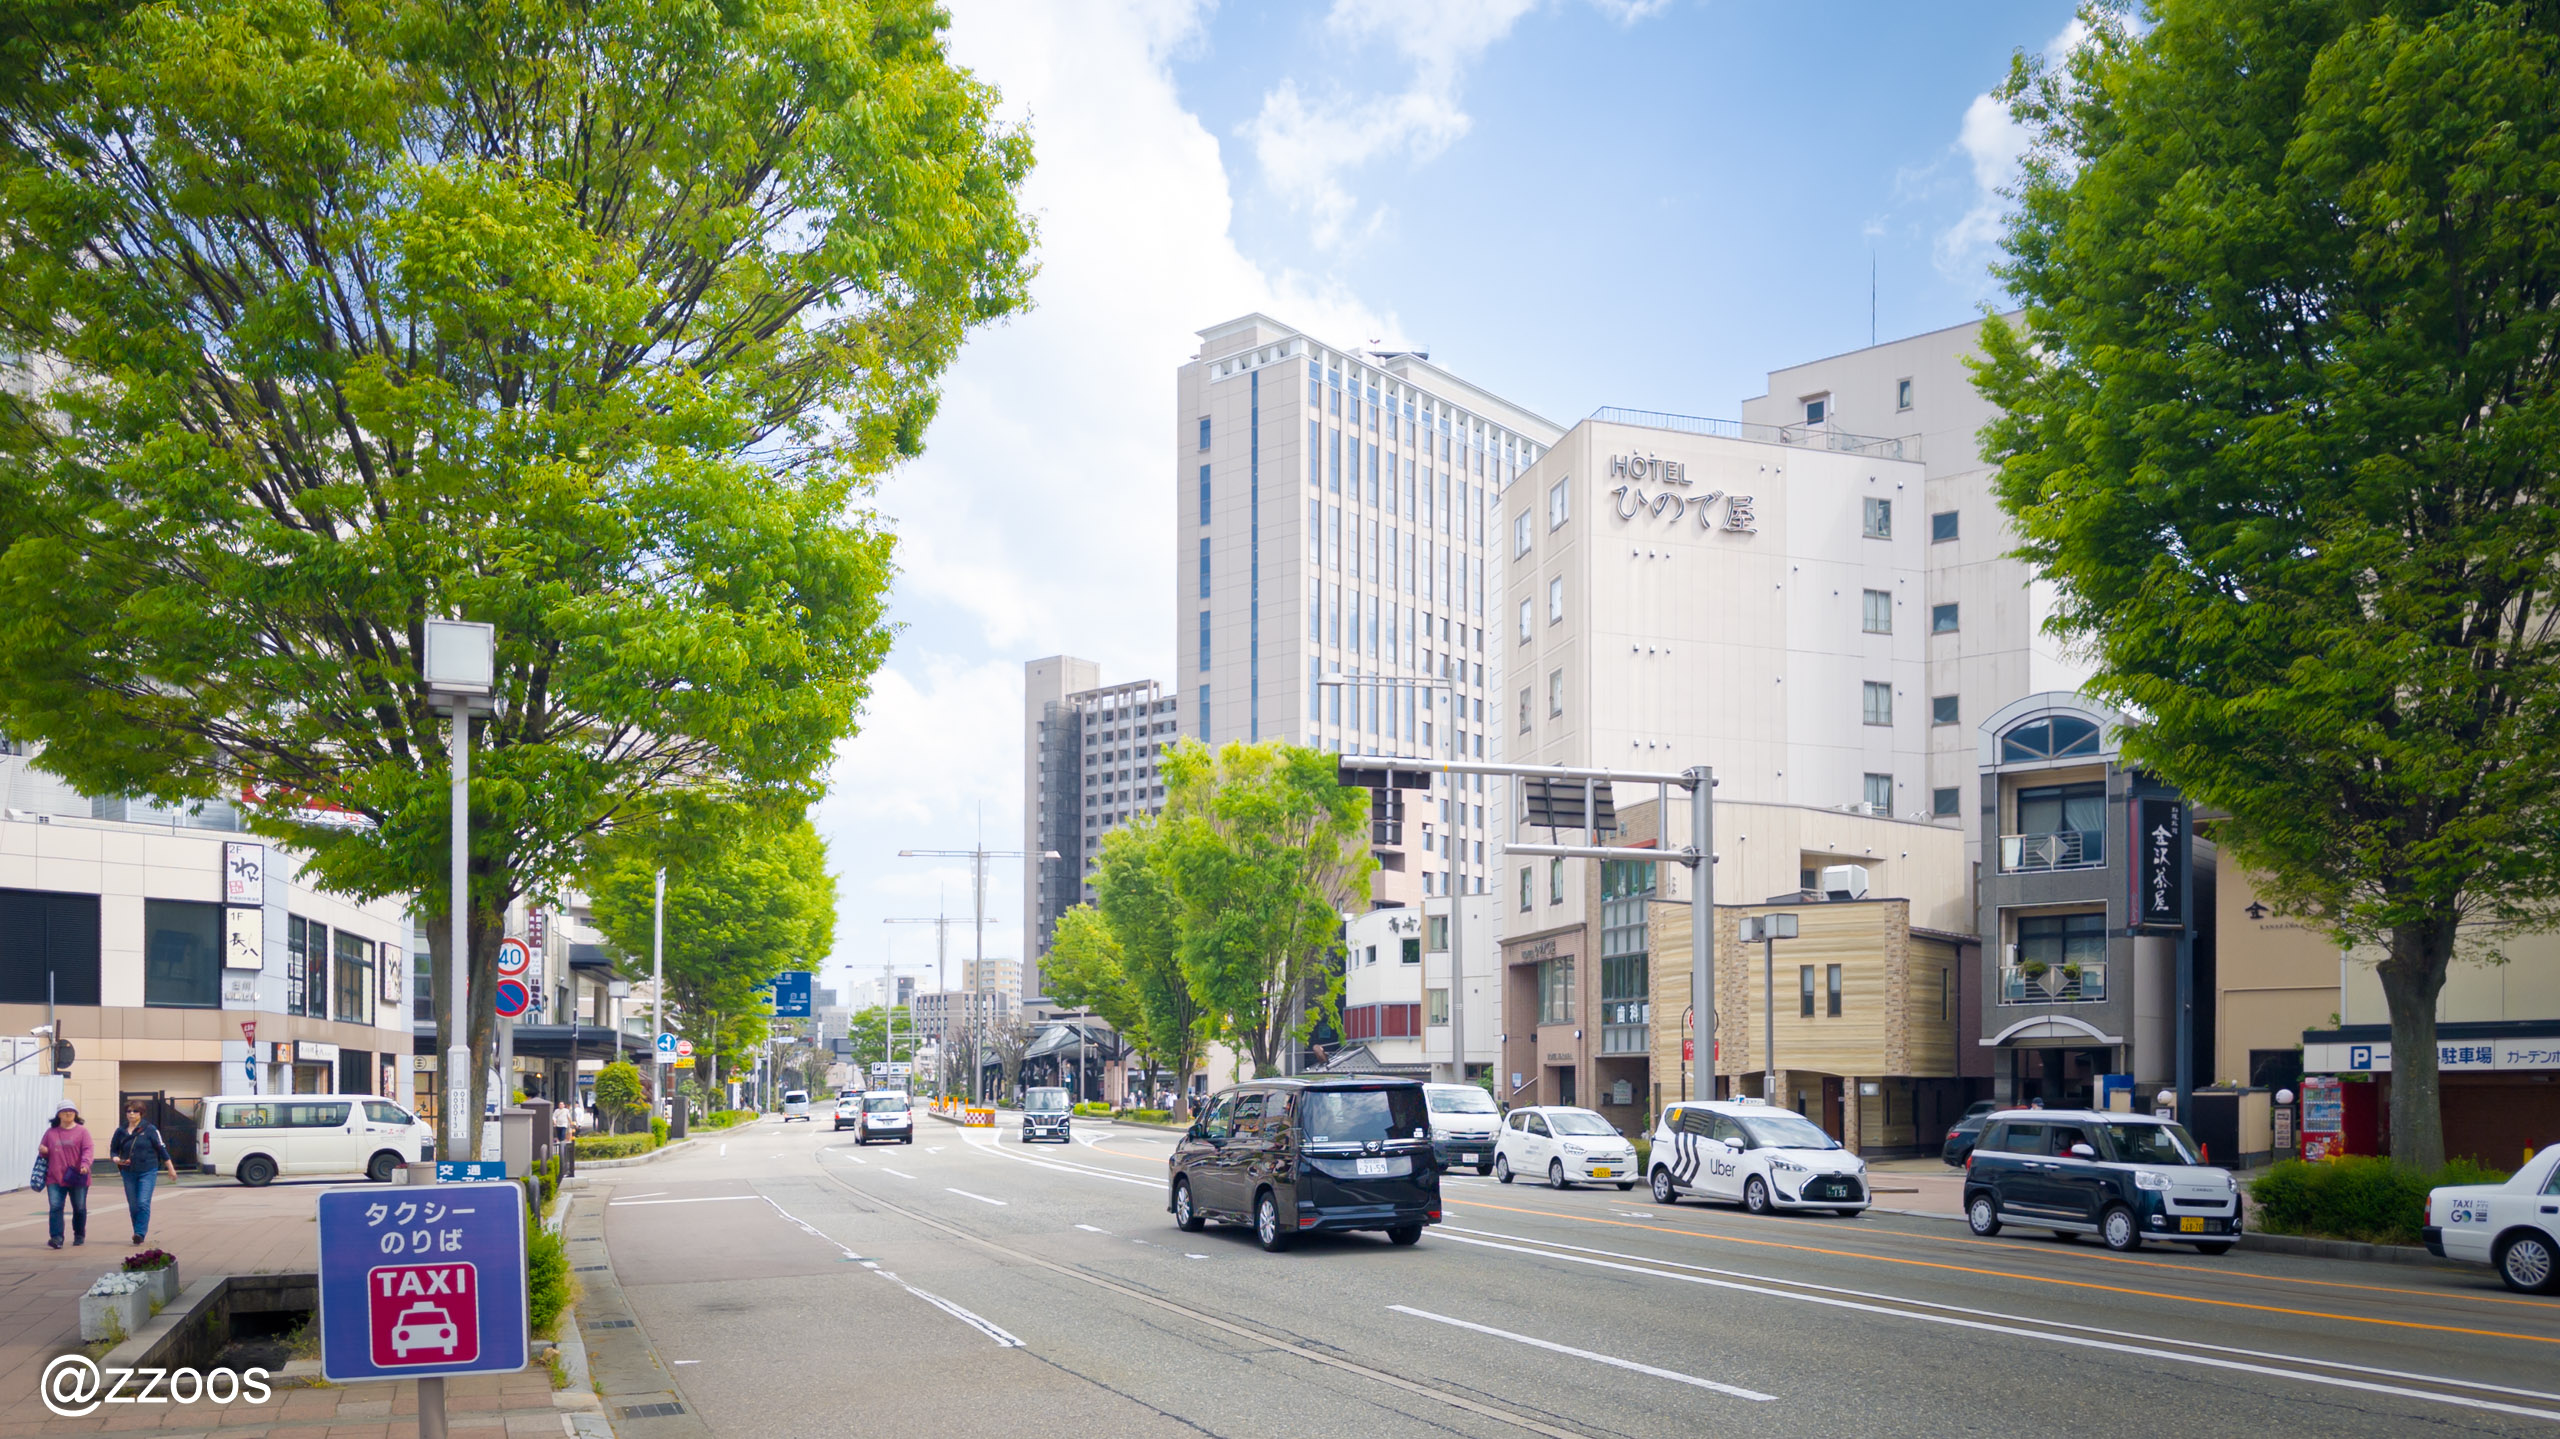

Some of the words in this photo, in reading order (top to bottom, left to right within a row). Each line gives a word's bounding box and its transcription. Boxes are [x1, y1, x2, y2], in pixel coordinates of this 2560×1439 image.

[1611, 454, 1694, 486] HOTEL
[1611, 485, 1758, 535] ひので屋
[229, 844, 243, 855] 2F
[2151, 824, 2173, 912] 金沢茶屋
[230, 912, 244, 921] 1F
[1388, 914, 1421, 934] 高崎
[498, 948, 521, 966] 40
[1616, 1002, 1640, 1024] 歯科
[439, 1164, 482, 1176] 交通
[1710, 1158, 1736, 1177] Uber
[2452, 1199, 2473, 1208] TAXI
[364, 1201, 476, 1227] タクシー
[2451, 1209, 2472, 1223] GO
[380, 1228, 463, 1254] のりば
[377, 1268, 466, 1297] TAXI
